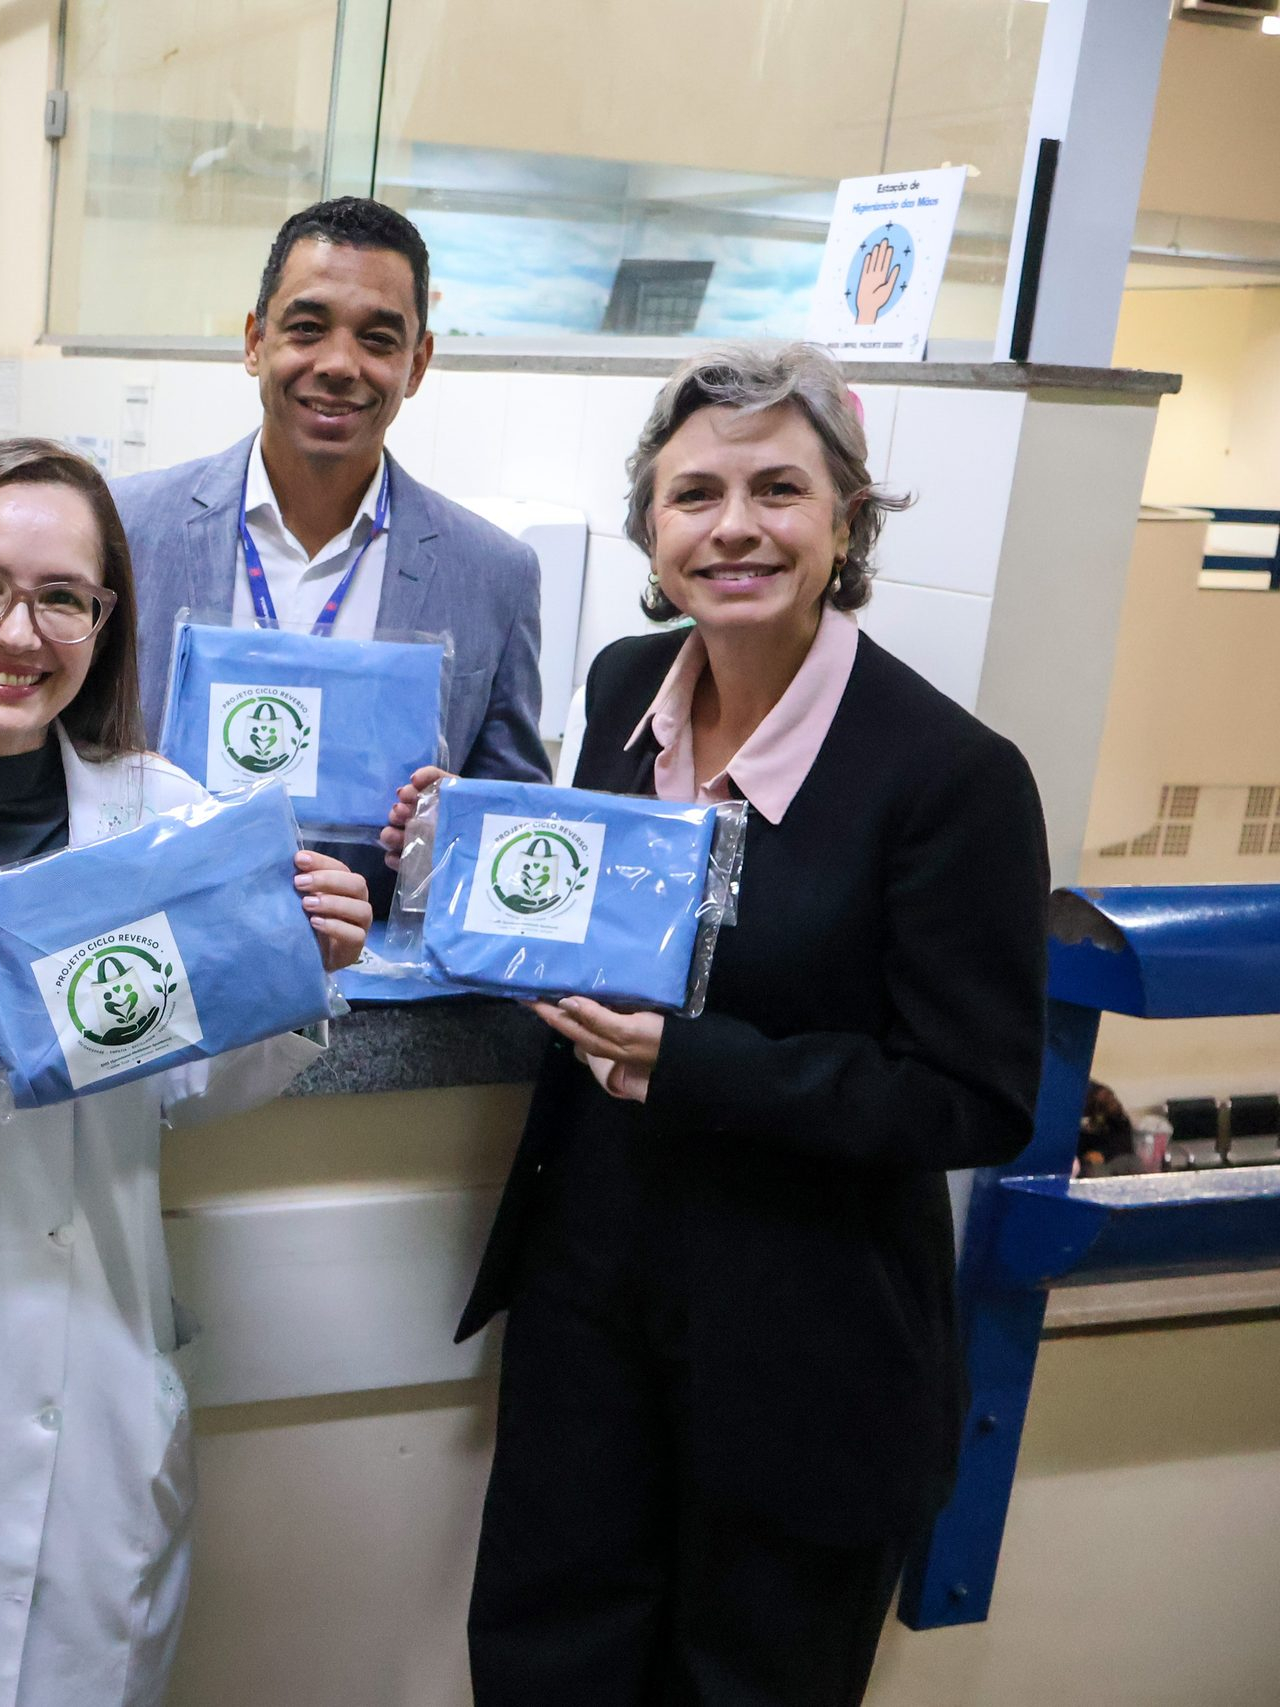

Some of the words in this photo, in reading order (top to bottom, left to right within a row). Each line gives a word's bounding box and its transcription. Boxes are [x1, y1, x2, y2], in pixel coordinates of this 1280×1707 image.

[877, 181, 909, 194] Estação
[909, 179, 921, 190] de
[222, 689, 254, 709] PROJETO
[279, 691, 308, 713] REVERSO
[532, 822, 557, 830] CICLO
[558, 826, 588, 852] REVERSO
[56, 949, 86, 987] PROJETO
[87, 935, 115, 951] CICLO
[118, 934, 159, 949] REVERSO
